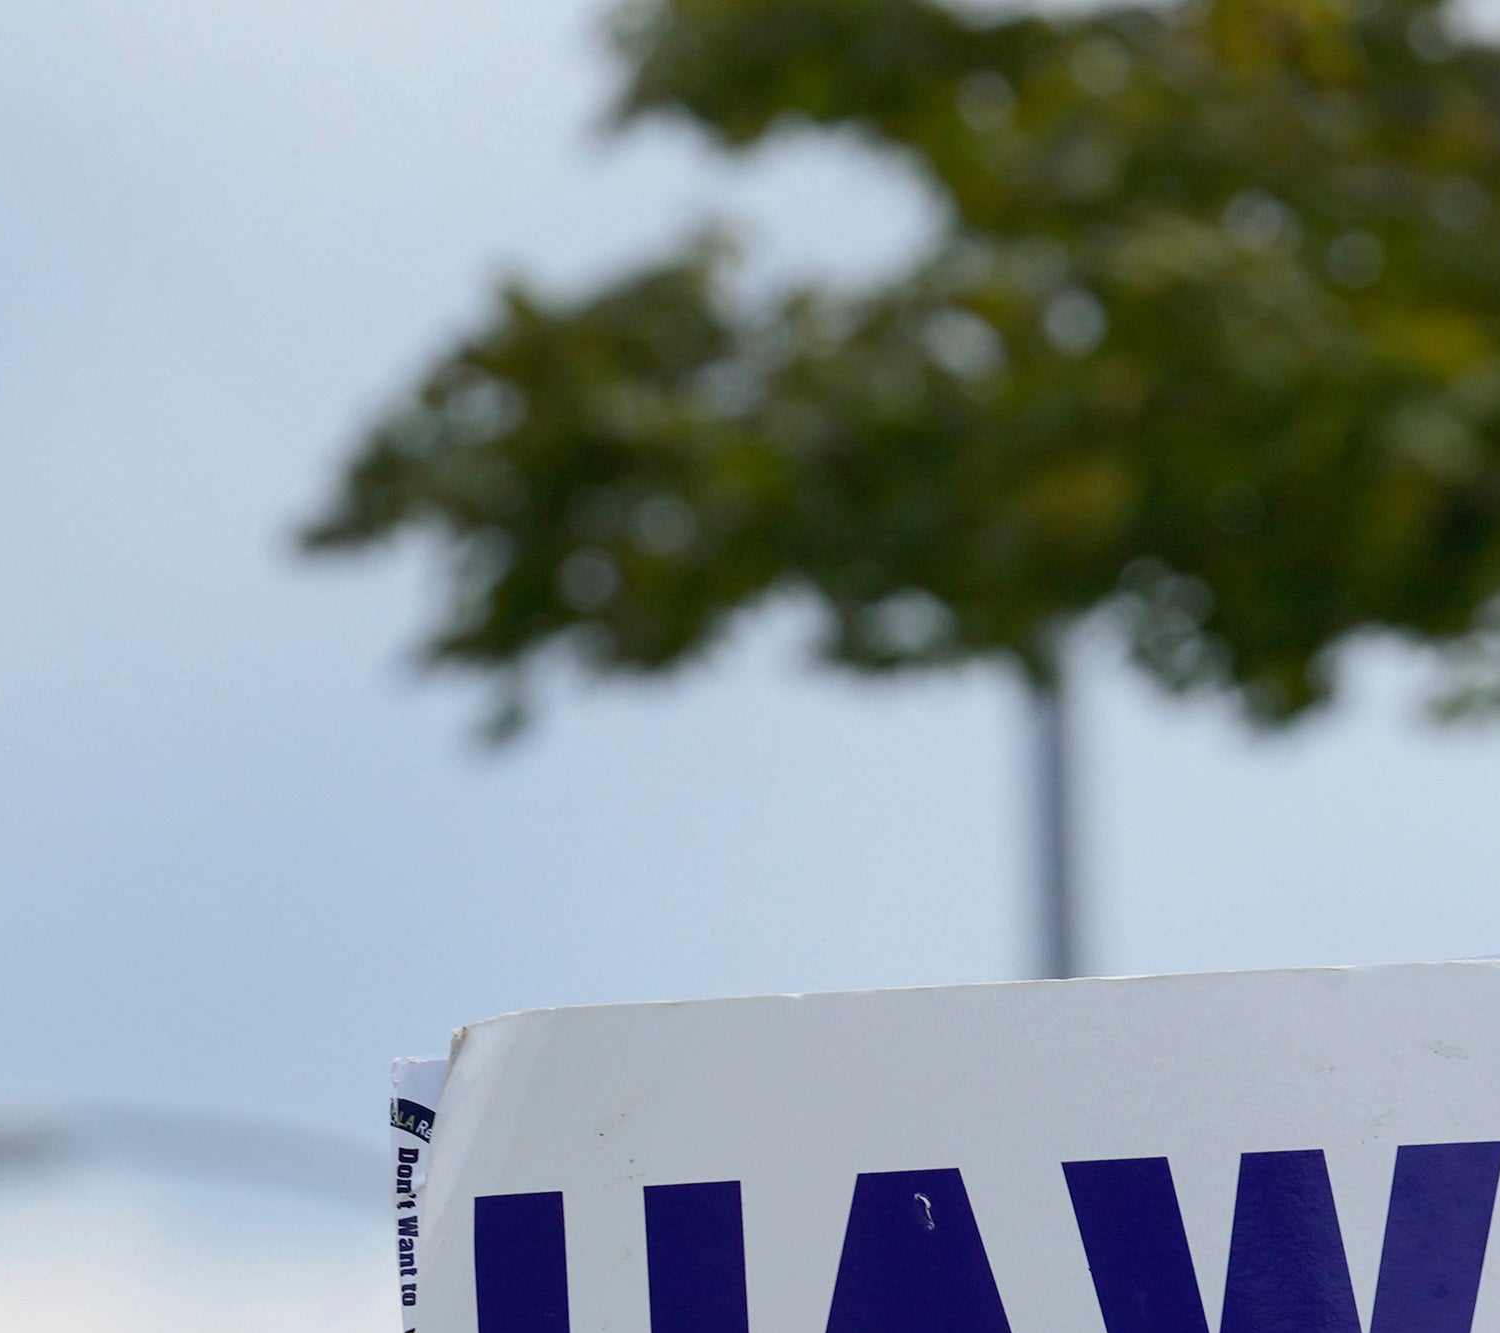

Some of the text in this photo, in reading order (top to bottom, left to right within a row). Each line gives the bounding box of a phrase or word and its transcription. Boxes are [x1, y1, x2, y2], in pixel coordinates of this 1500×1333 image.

[396, 1147, 419, 1210] Don't
[398, 1215, 419, 1277] Want
[401, 1283, 417, 1306] to
